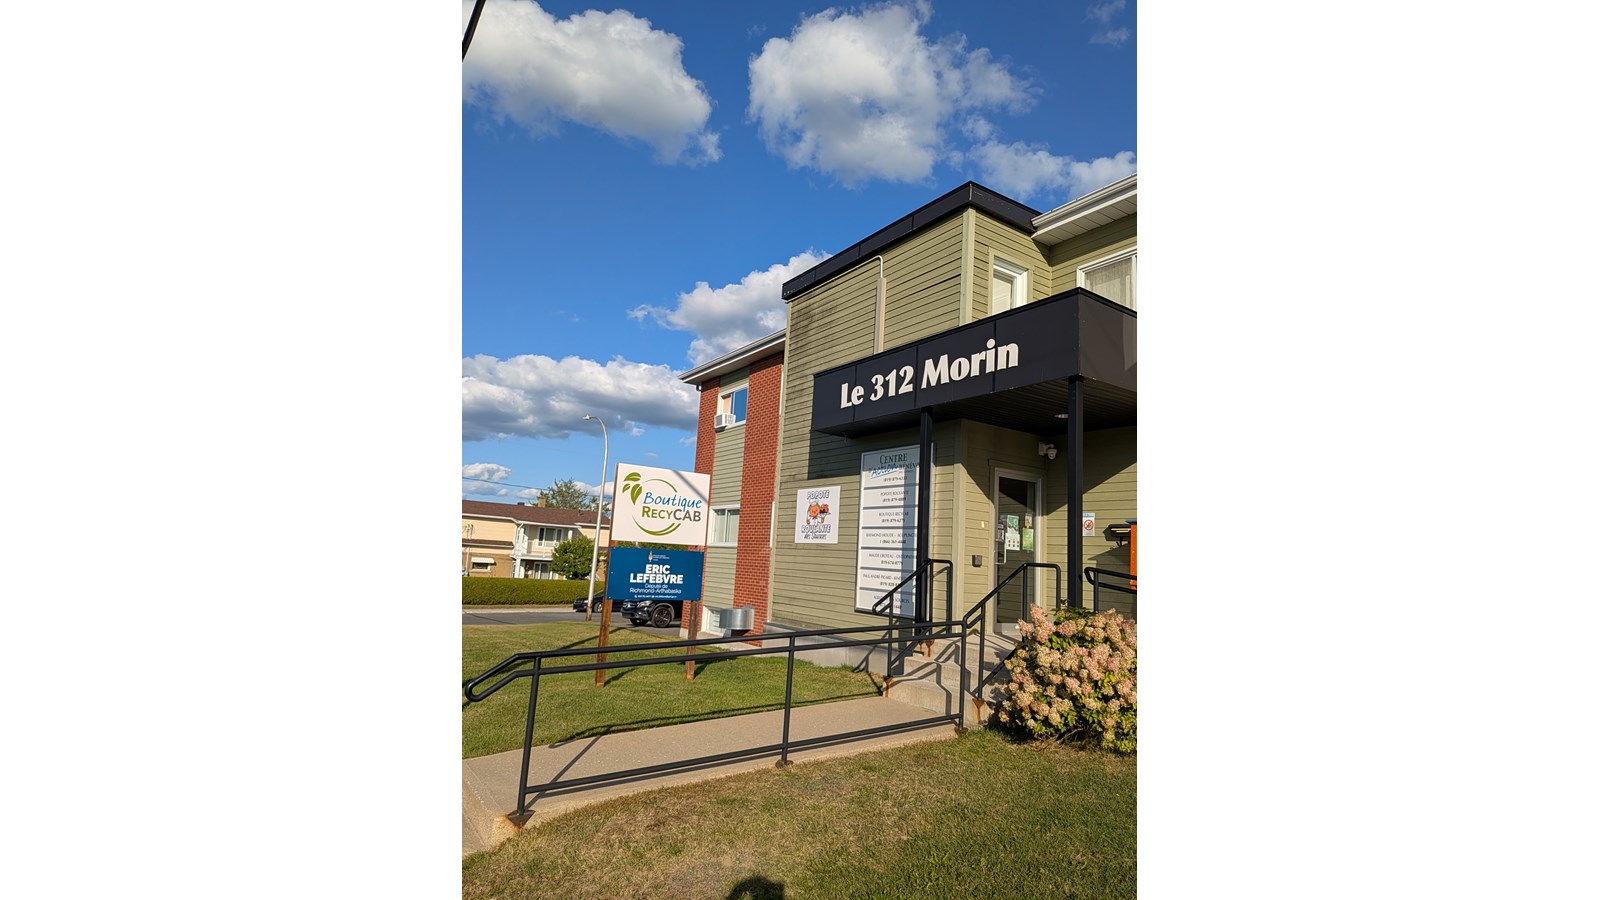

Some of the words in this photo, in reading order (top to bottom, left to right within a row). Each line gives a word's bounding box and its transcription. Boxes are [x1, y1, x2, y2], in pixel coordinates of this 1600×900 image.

[840, 382, 865, 409] Le
[870, 365, 914, 401] 312
[921, 338, 1019, 389] Morin
[880, 453, 908, 465] CENTRE
[807, 490, 830, 500] POPOTE
[643, 491, 703, 512] Boutique
[801, 524, 831, 533] ROULANTE
[645, 564, 671, 574] ERIC
[629, 573, 684, 584] LEFEBVRE
